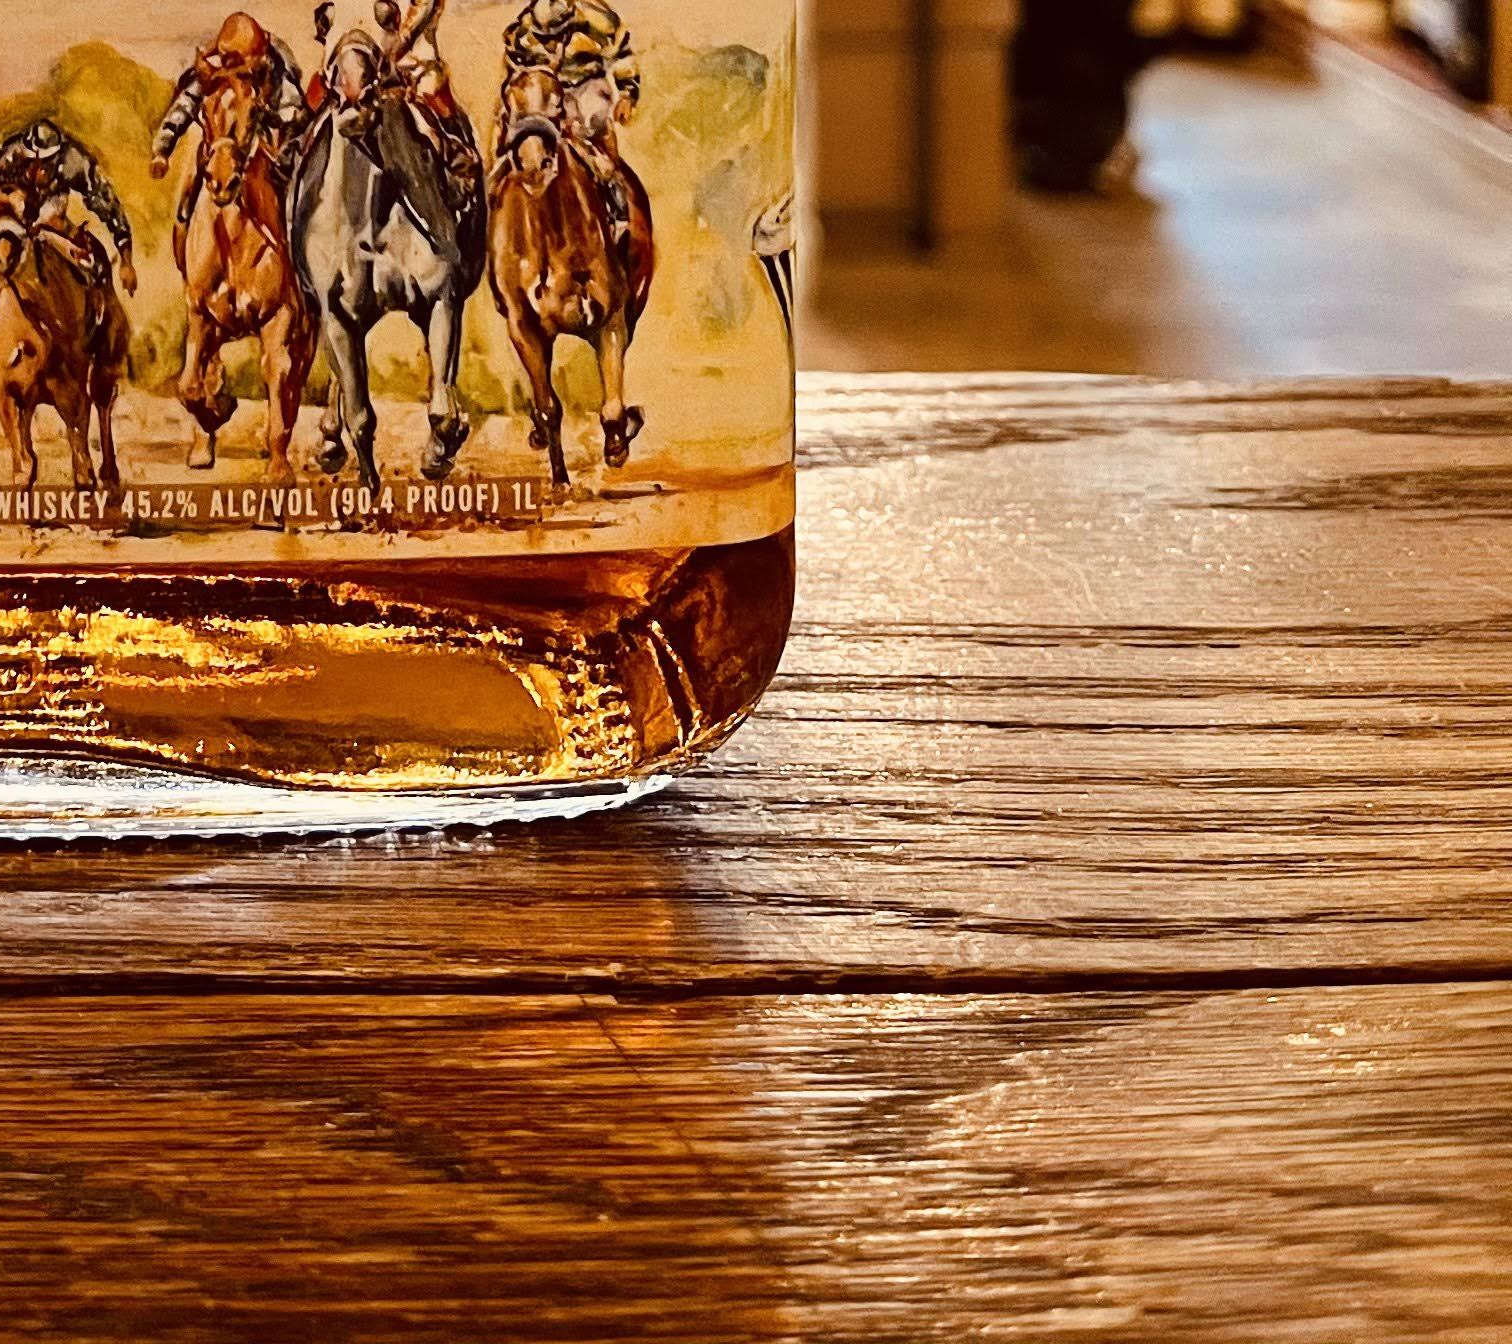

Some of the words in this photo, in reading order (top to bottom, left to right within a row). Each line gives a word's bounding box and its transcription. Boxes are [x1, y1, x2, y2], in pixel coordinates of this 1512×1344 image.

[120, 488, 198, 519] 45.2%
[208, 486, 320, 521] ALC/VOL
[329, 485, 395, 518] (90.4
[405, 483, 500, 516] PROOF)
[511, 482, 539, 512] 1L
